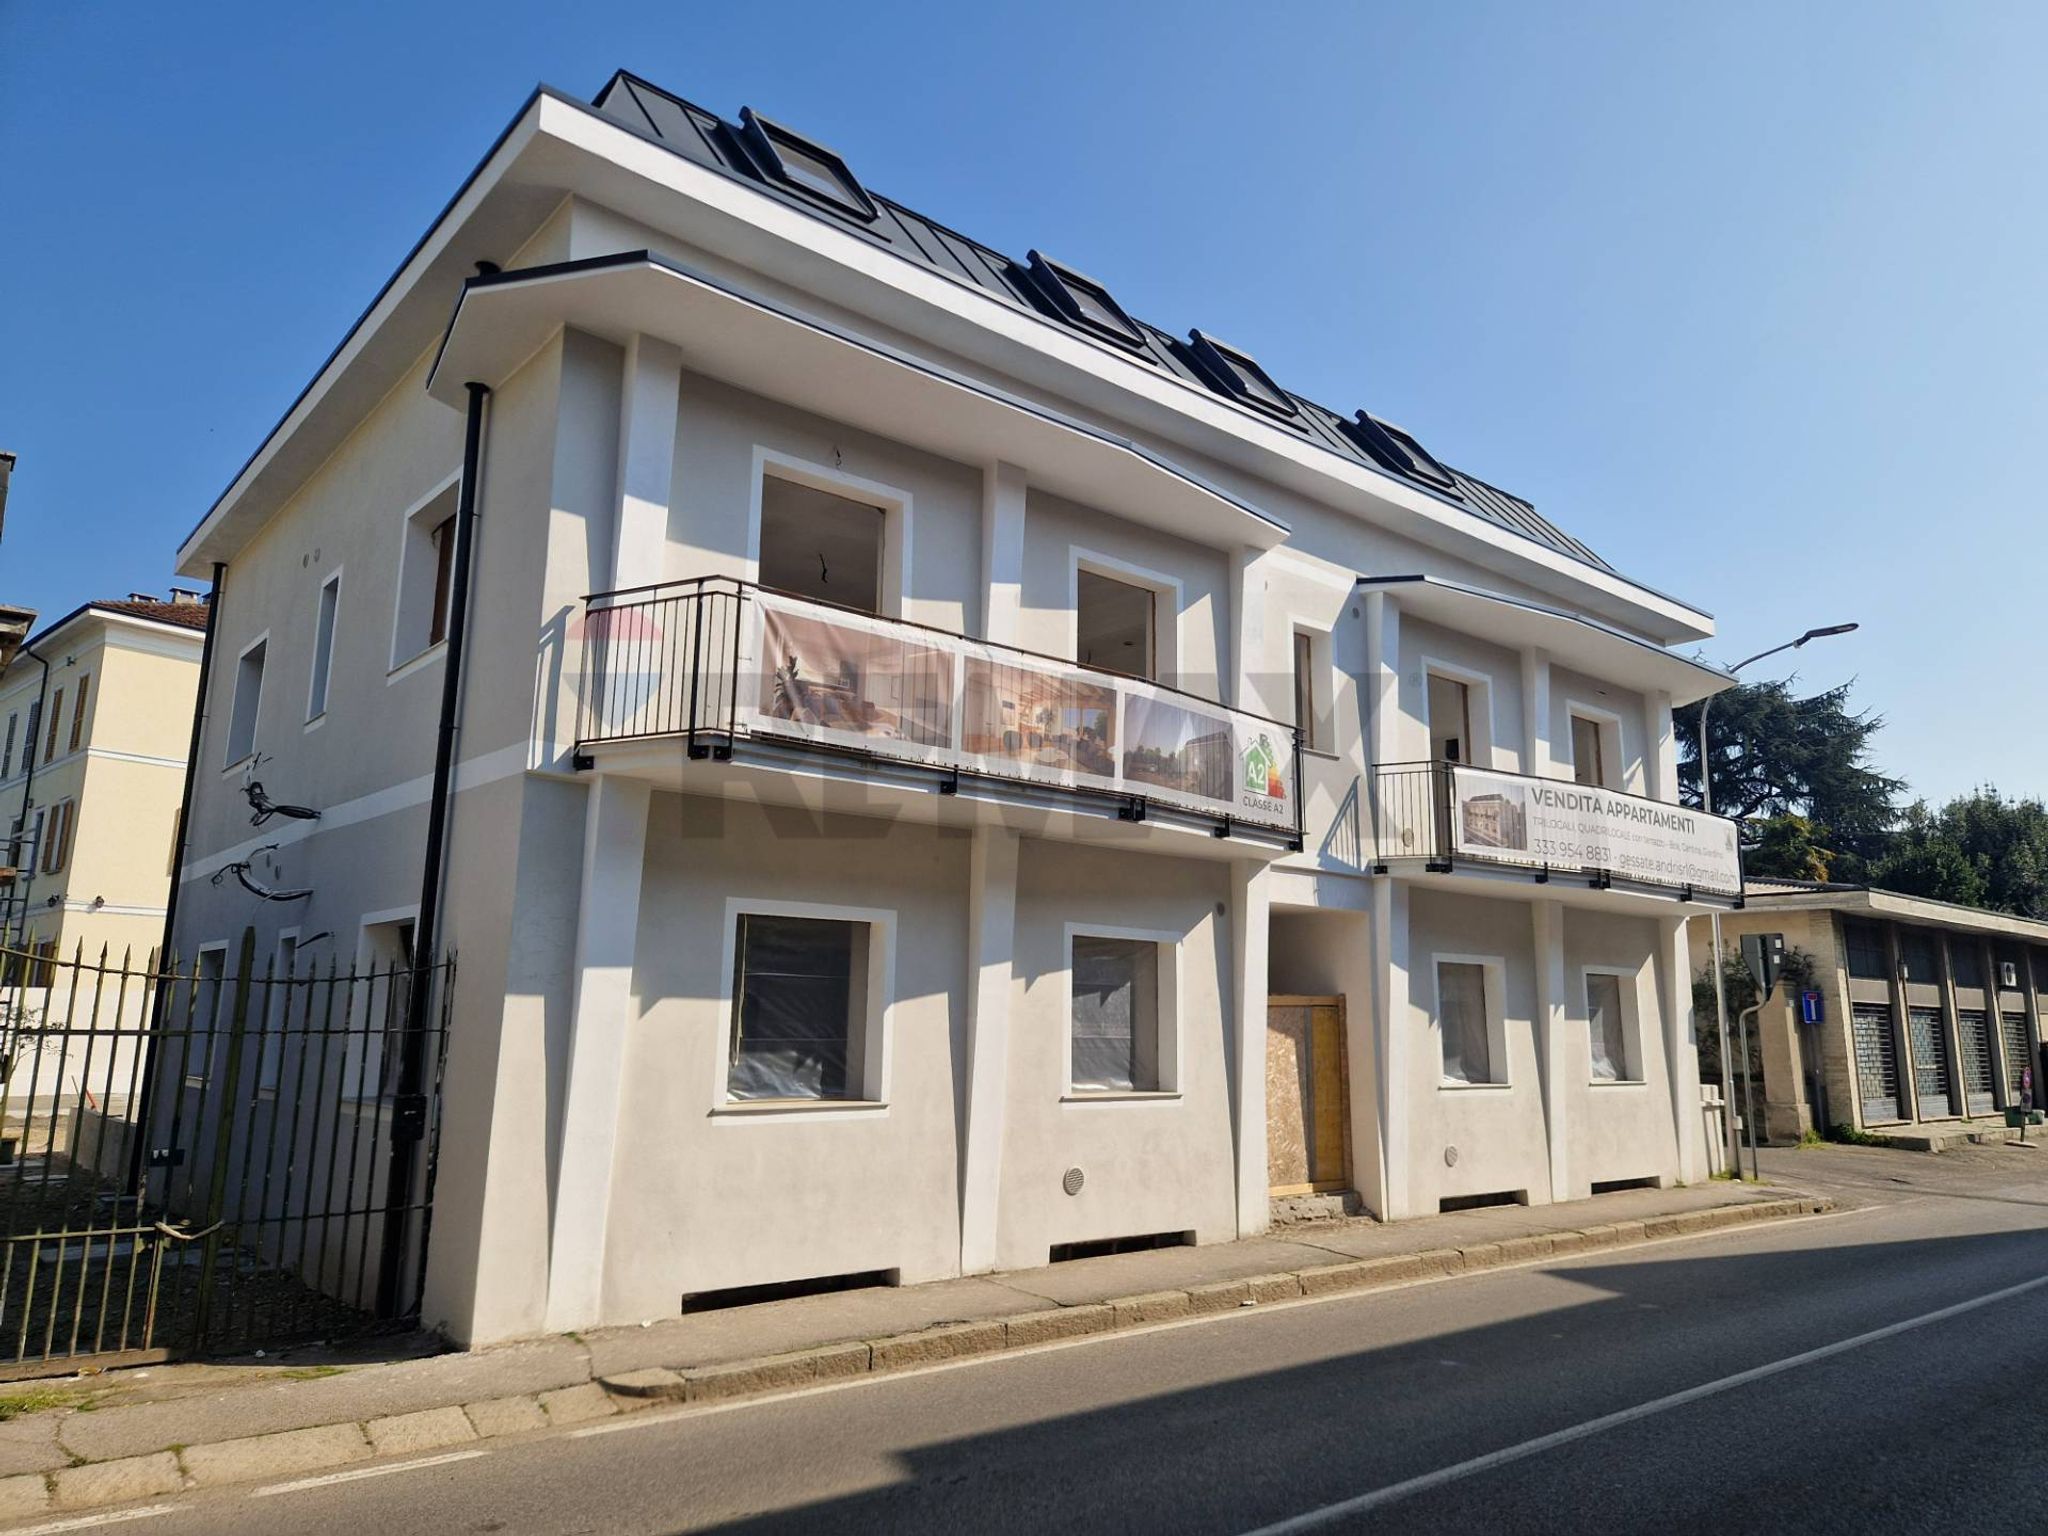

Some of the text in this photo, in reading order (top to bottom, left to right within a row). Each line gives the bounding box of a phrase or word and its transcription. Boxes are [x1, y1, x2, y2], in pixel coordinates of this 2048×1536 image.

[1248, 761, 1266, 784] A2
[1242, 796, 1284, 815] CLASSE A2
[1531, 787, 1695, 835] VENDITA APPARTAMENTI
[1534, 839, 1556, 855] 333
[1560, 842, 1583, 858] 954
[1586, 845, 1612, 862] 8831
